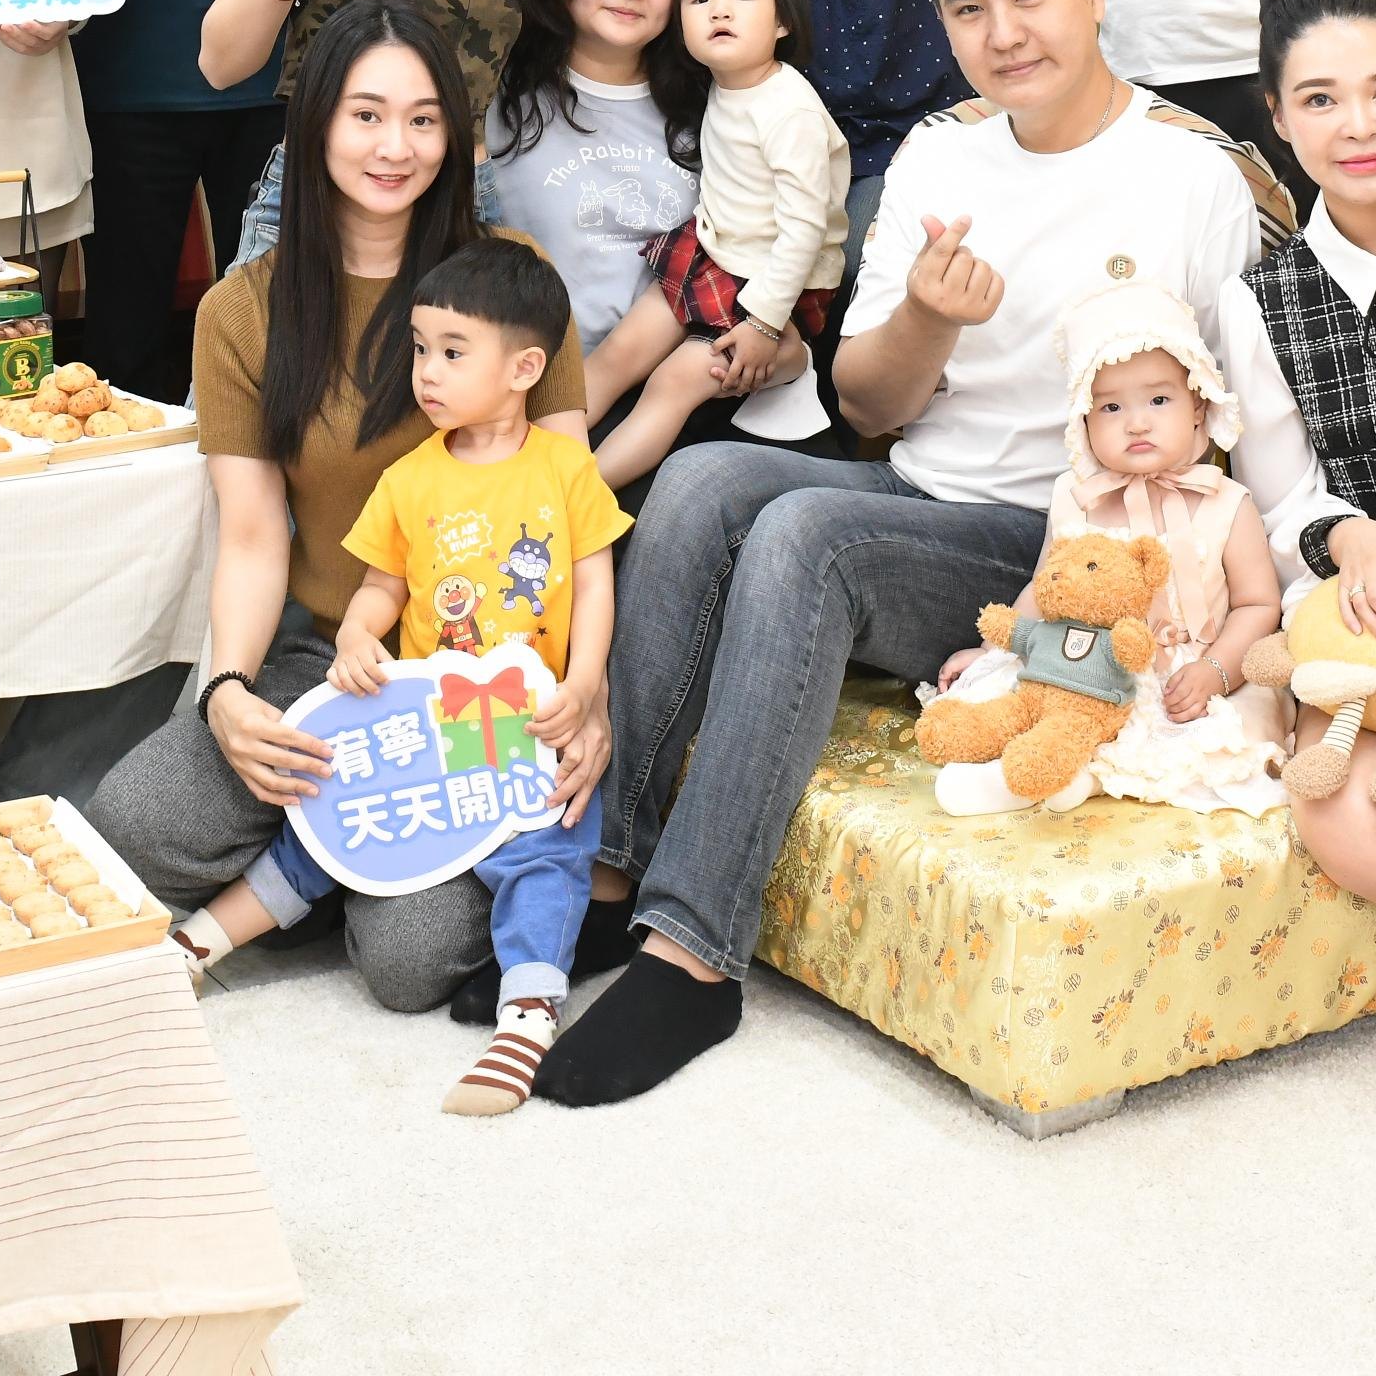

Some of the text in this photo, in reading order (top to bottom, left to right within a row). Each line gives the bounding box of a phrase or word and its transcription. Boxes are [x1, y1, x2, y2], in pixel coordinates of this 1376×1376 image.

[544, 159, 580, 189] The
[579, 144, 656, 165] Rabbit
[329, 713, 428, 785] 宥寧
[336, 763, 555, 851] 天天開心
